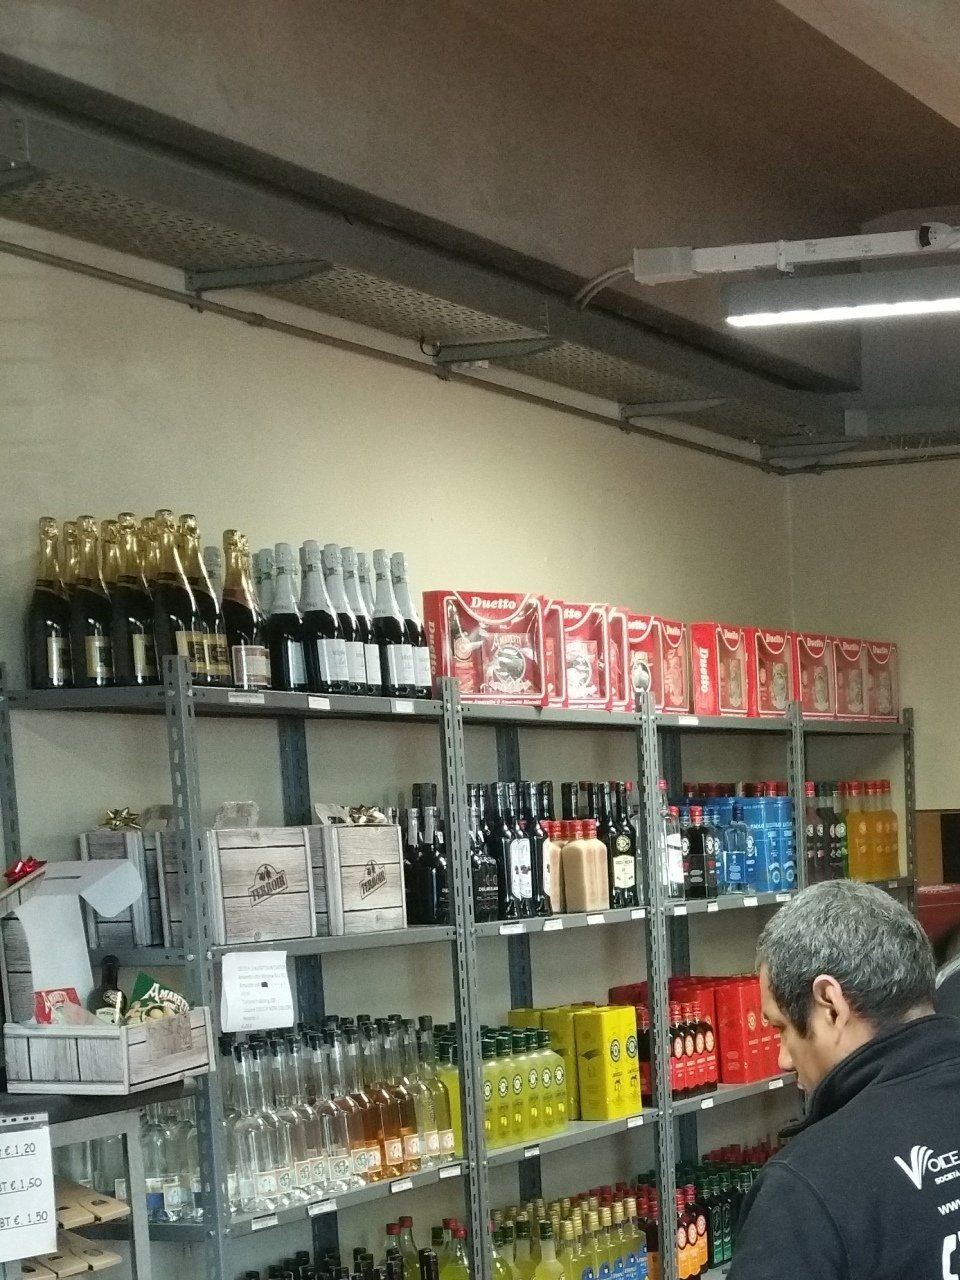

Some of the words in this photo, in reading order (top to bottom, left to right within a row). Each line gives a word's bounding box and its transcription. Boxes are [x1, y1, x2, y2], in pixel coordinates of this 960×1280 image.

[470, 596, 516, 610] Duetto
[699, 647, 709, 694] Duetto
[251, 874, 286, 902] TERROIR
[360, 869, 386, 895] TERROIR
